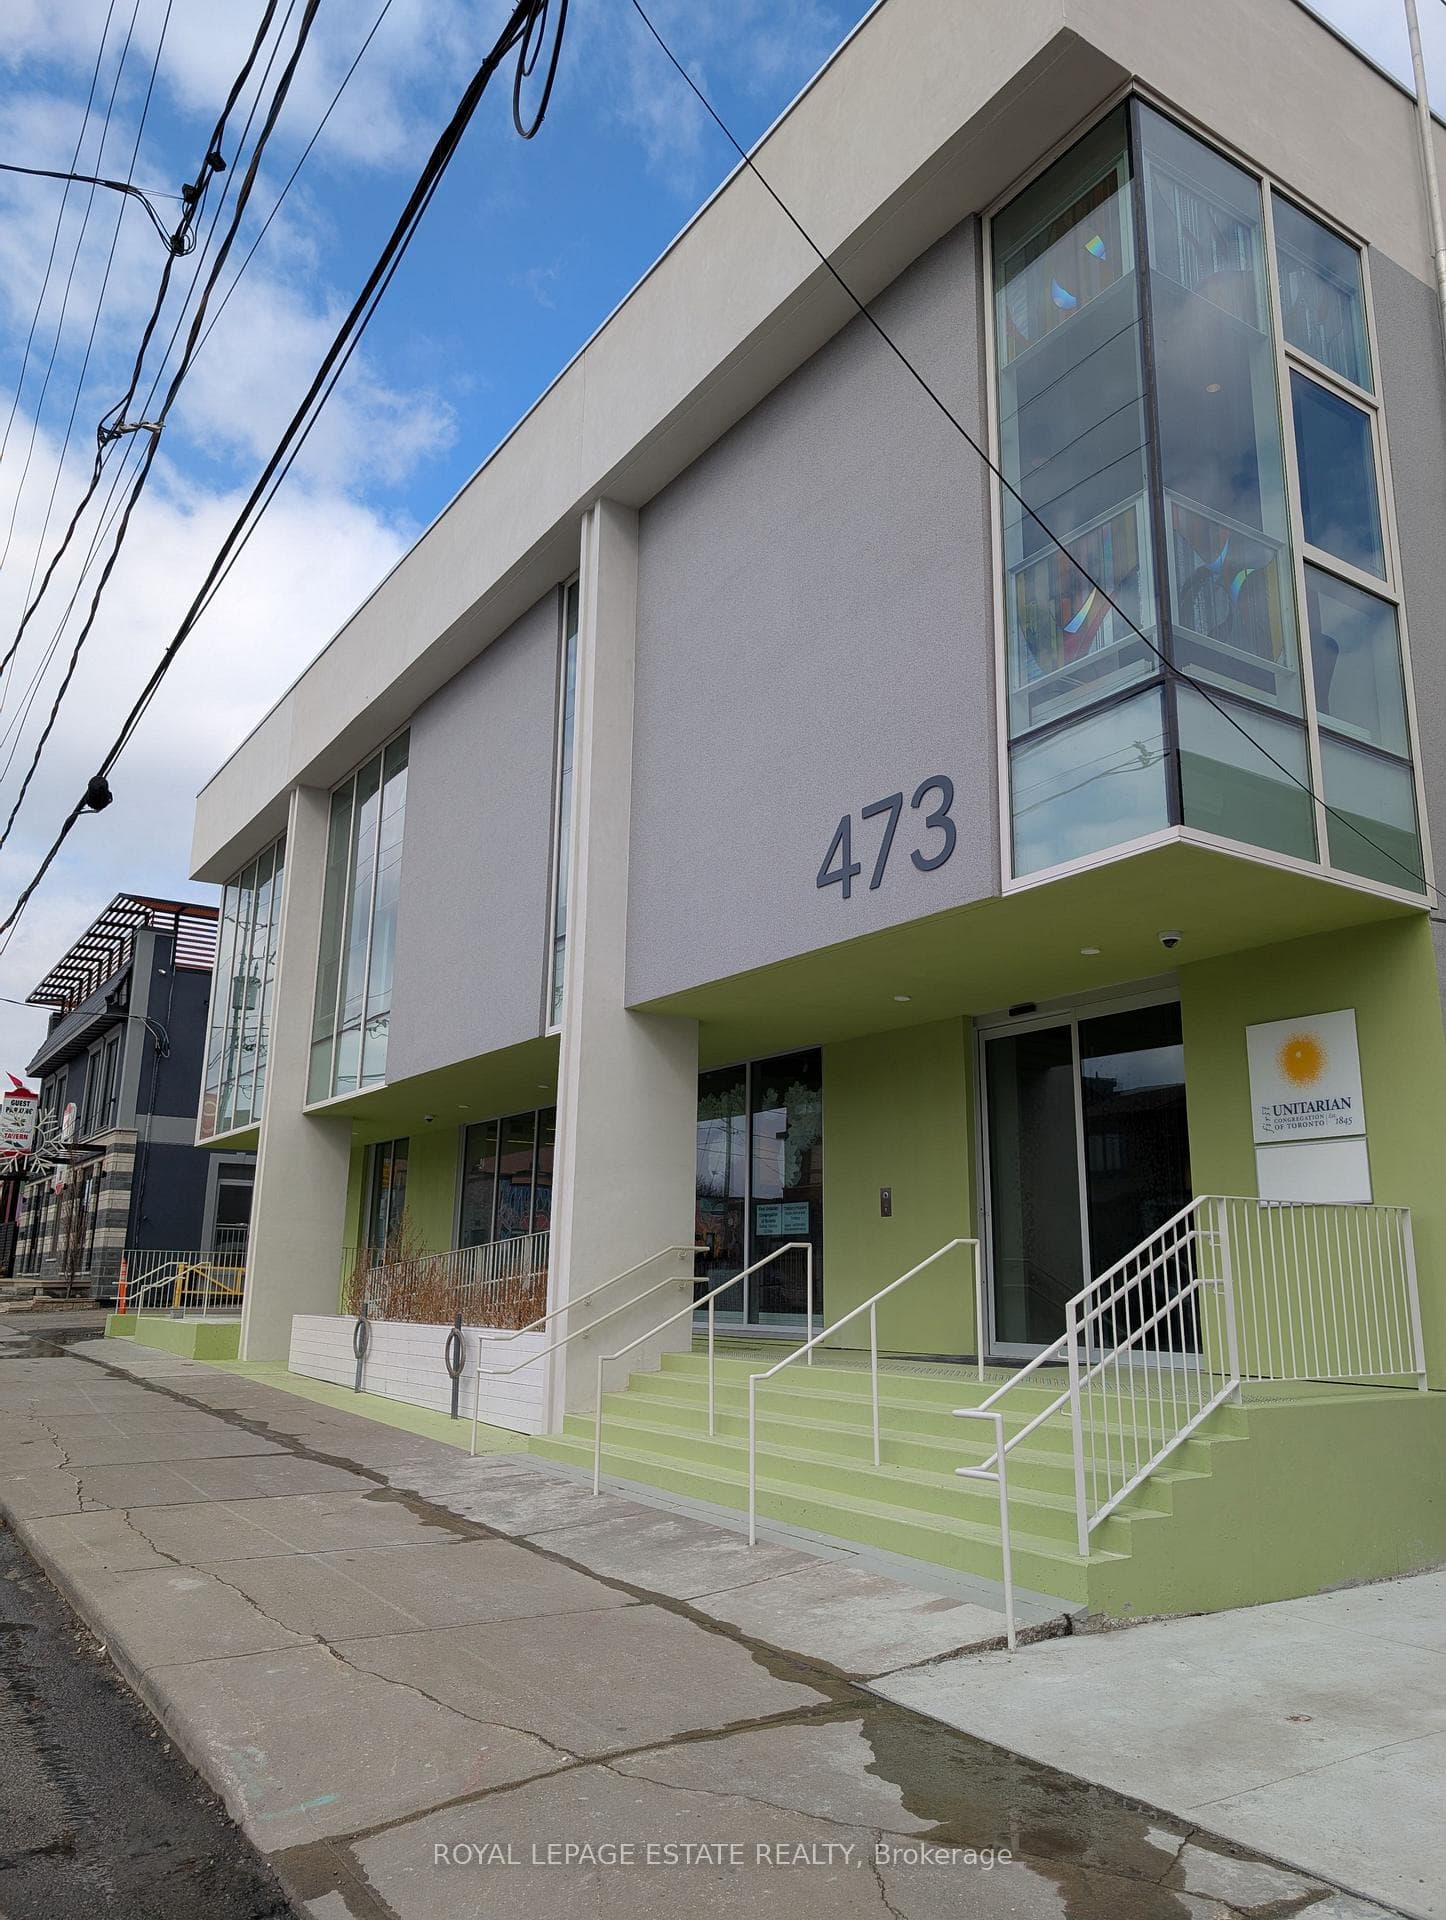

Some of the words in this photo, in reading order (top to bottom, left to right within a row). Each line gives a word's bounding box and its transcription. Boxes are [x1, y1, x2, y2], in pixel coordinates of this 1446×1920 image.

[816, 775, 957, 899] 473
[10, 1099, 31, 1107] GUEST
[1273, 1096, 1352, 1116] UNITARIAN
[1274, 1113, 1325, 1123] CONGREGATION
[1335, 1116, 1353, 1125] 1845
[1274, 1123, 1284, 1131] OF
[1287, 1119, 1325, 1130] TORONTO
[4, 1132, 29, 1140] TAVERN
